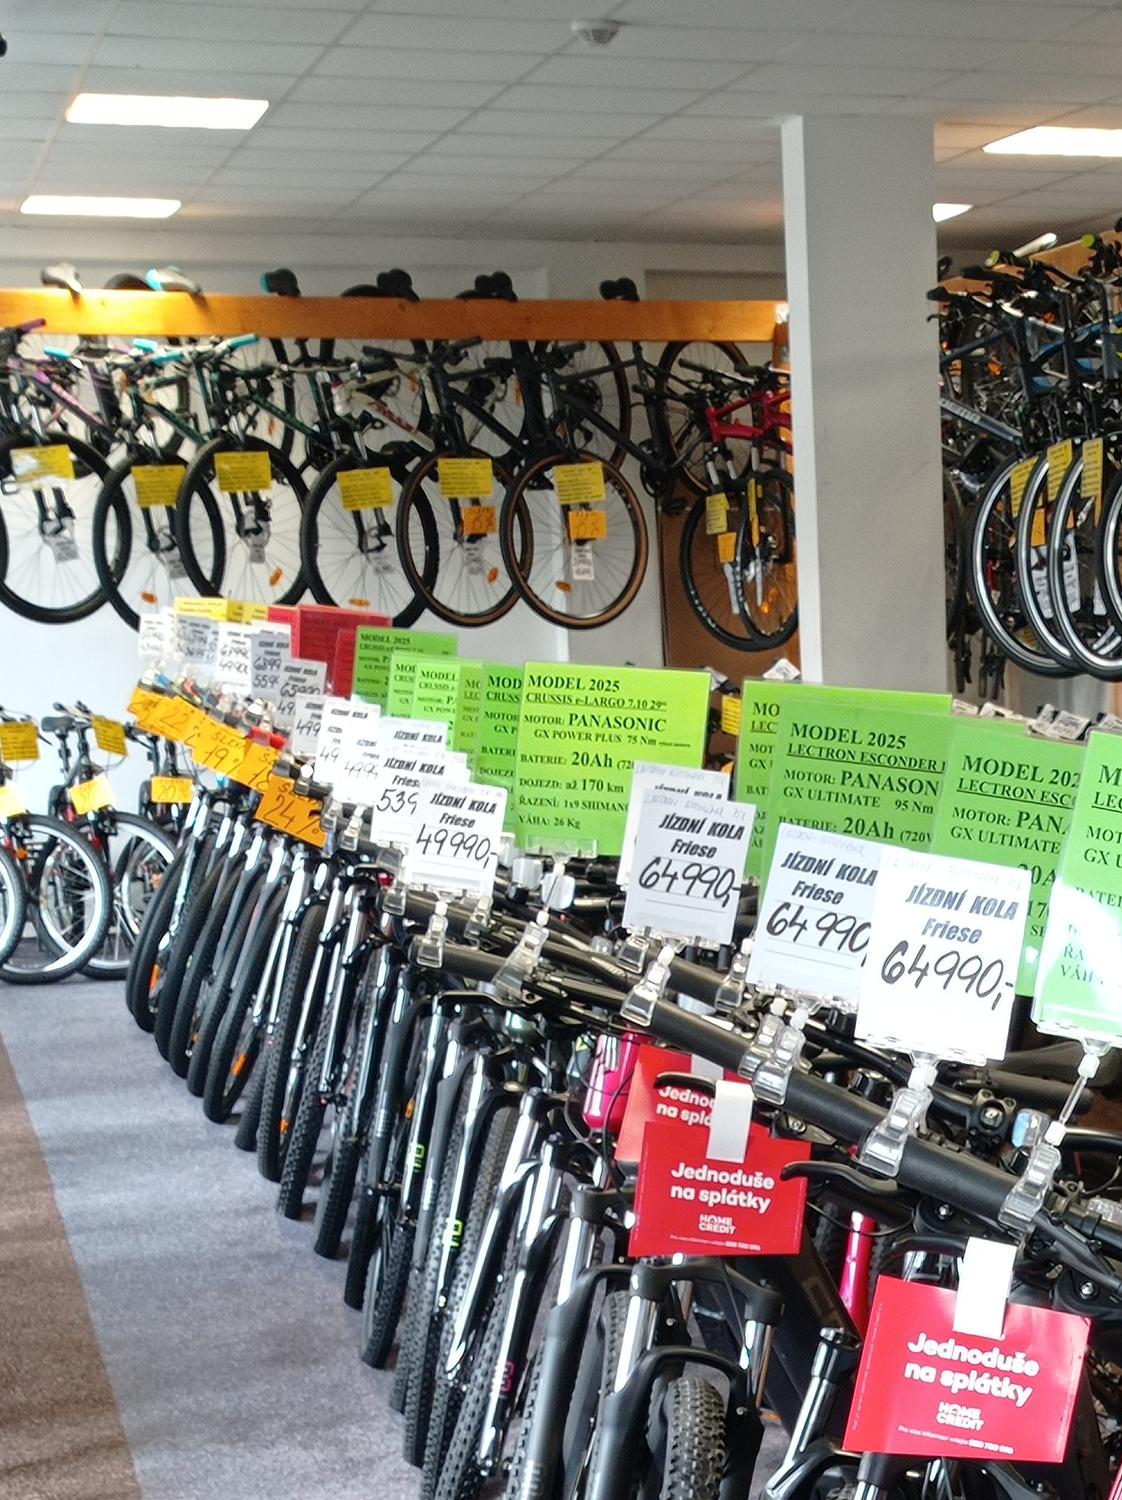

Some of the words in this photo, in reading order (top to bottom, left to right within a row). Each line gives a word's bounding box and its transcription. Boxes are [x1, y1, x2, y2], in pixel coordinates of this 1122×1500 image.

[528, 675, 585, 690] MODEL
[589, 679, 620, 692] 2025
[526, 692, 572, 705] CRUSSIS
[523, 714, 564, 726] MOTOR:
[569, 713, 667, 732] PANASONIC
[534, 729, 550, 739] GX
[552, 730, 592, 742] POWER
[595, 732, 622, 743] PLUS
[628, 735, 638, 745] 75
[640, 736, 656, 746] Nm
[790, 722, 863, 744] MODEL
[867, 732, 907, 749] 2025
[384, 757, 416, 771] JÍZDNÍ
[419, 764, 445, 775] KOLA
[520, 754, 567, 765] BATERIE:
[571, 751, 613, 769] 20Ah
[788, 743, 855, 762] LECTRON
[860, 752, 936, 771] ESCONDER
[962, 755, 1043, 783] MODEL
[519, 778, 562, 790] DOJEZD:
[582, 780, 604, 792] 170
[607, 782, 624, 793] km
[785, 769, 836, 785] MOTOR:
[840, 771, 940, 797] PANASON
[958, 778, 1036, 800] LECTRON
[430, 793, 466, 808] JÍZDNÍ
[468, 800, 497, 814] KOLA
[783, 786, 804, 800] GX
[808, 789, 881, 808] ULTIMATE
[895, 800, 908, 812] 95
[911, 801, 934, 814] Nm
[440, 813, 475, 828] Friese
[518, 815, 550, 826] VÁHA:
[554, 817, 564, 827] 26
[659, 813, 705, 835] JÍZDNÍ
[707, 822, 744, 841] KOLA
[952, 807, 1010, 826] MOTOR:
[843, 817, 894, 839] 20Ah
[670, 839, 717, 859] Friese
[950, 826, 972, 840] GX
[978, 830, 1061, 855] ULTIMATE
[781, 850, 836, 876] JÍZDNÍ
[835, 863, 878, 886] KOLA
[1083, 849, 1110, 866] GX
[792, 880, 844, 905] Friese
[905, 882, 968, 911] JÍZDNÍ
[969, 895, 1019, 920] KOLA
[921, 918, 982, 944] Friese
[656, 1103, 678, 1118] na
[671, 1163, 775, 1190] Jednoduše
[671, 1185, 695, 1201] na
[699, 1190, 771, 1214] splátky
[699, 1223, 736, 1235] CREDIT
[700, 1214, 733, 1225] HOME
[907, 1333, 1039, 1377] Jednoduše
[904, 1362, 936, 1384] na
[940, 1369, 1033, 1408] splátky
